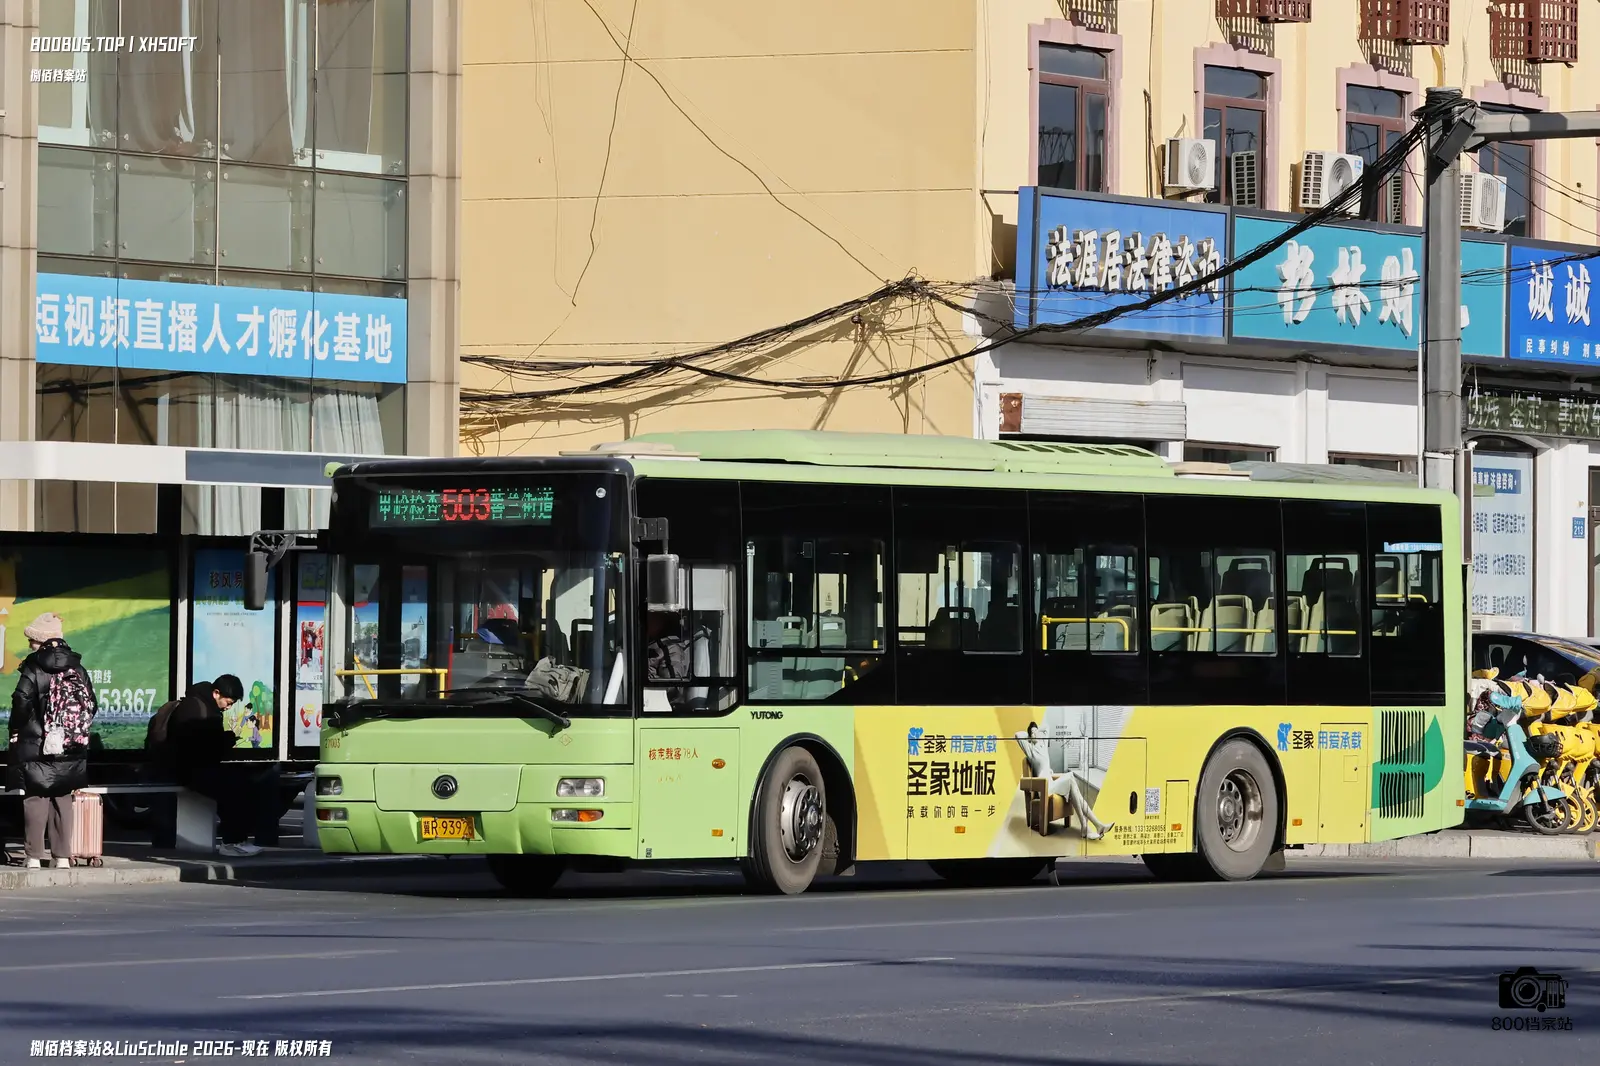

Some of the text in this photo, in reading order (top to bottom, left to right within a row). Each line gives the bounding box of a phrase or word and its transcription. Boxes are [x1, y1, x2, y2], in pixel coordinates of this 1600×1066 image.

[1276, 239, 1470, 338] 杉林财
[1527, 259, 1591, 327] 诚诚
[36, 292, 393, 364] 短视频直播人才孵化基地
[442, 488, 490, 521] 503
[1573, 525, 1584, 535] 213
[93, 688, 157, 713] 53367
[750, 710, 784, 720] YUTONG
[924, 734, 998, 754] 圣象 用爱承载
[1292, 729, 1362, 750] 圣象 用爱承载
[907, 760, 997, 796] 圣象地板
[906, 805, 996, 819] 承载你的每一步
